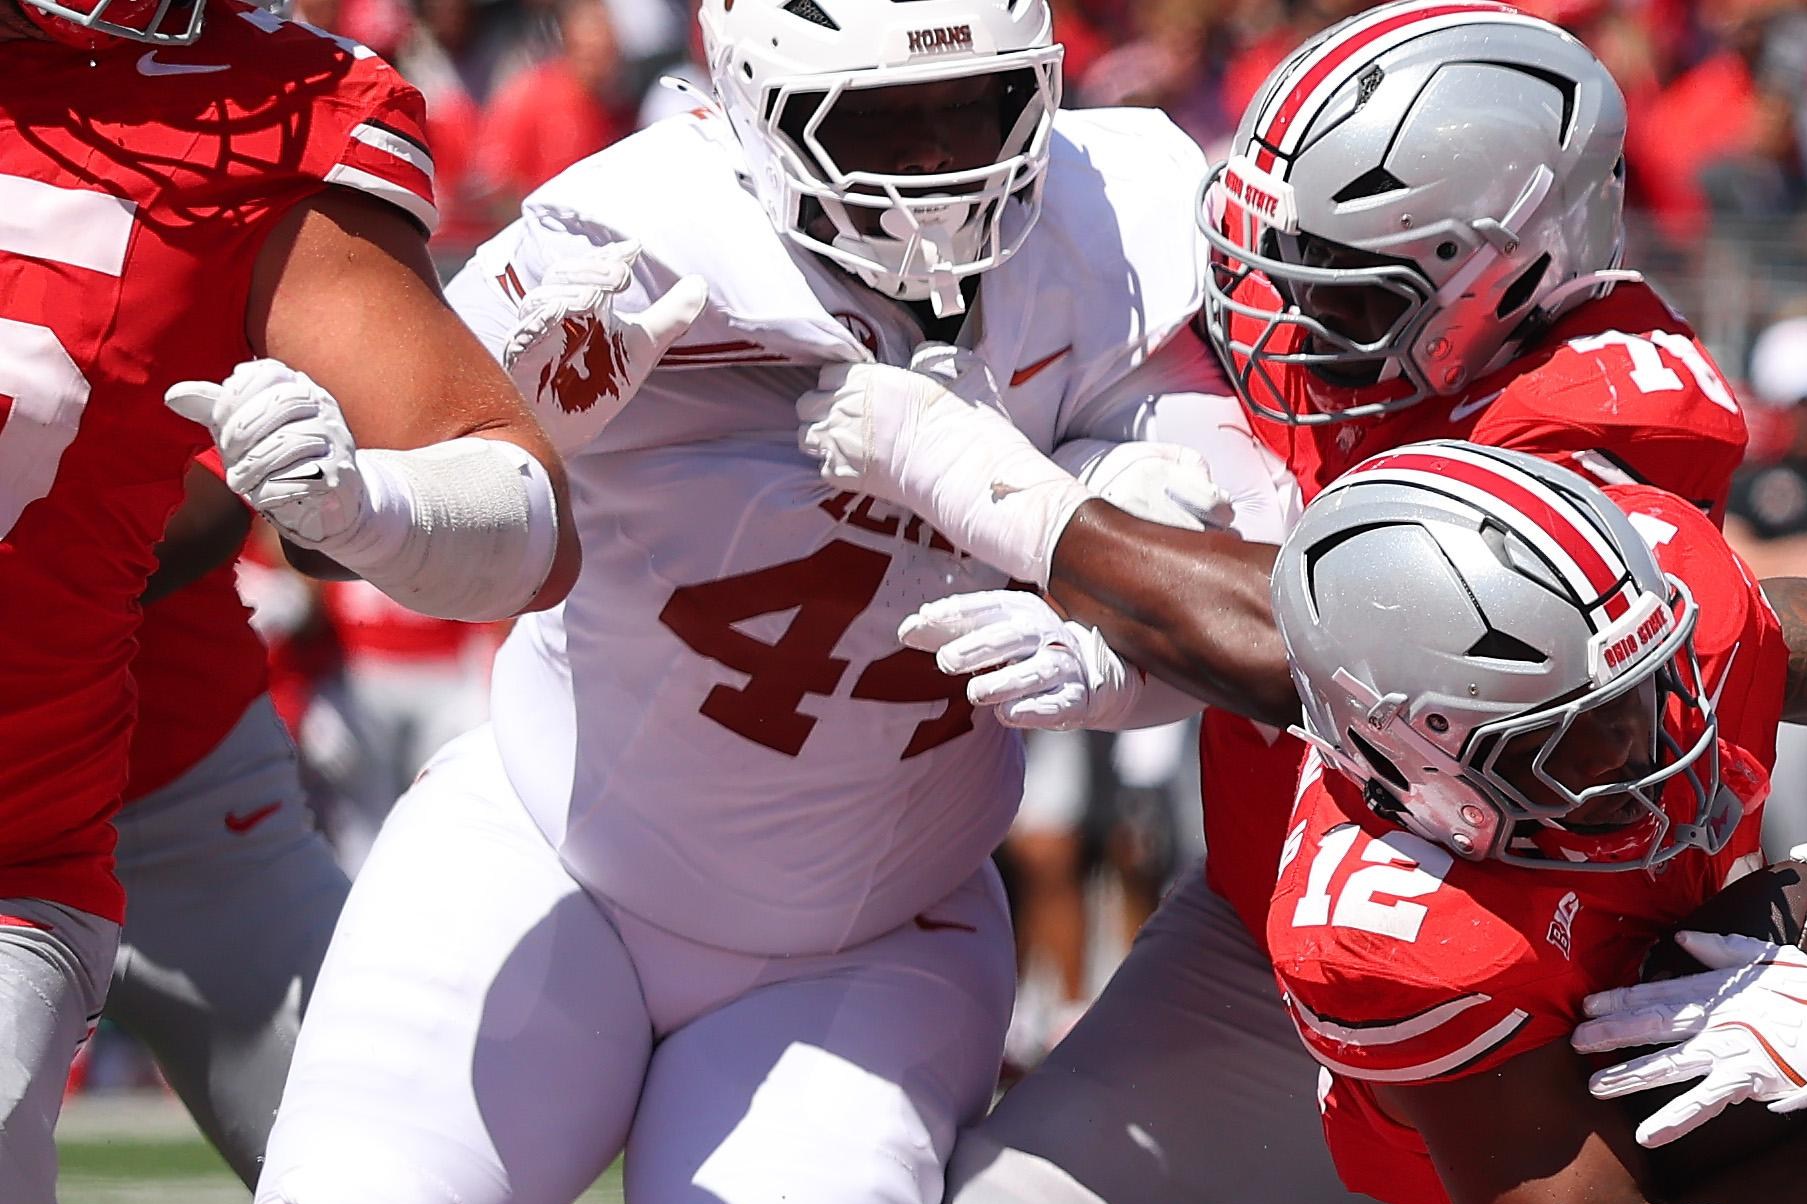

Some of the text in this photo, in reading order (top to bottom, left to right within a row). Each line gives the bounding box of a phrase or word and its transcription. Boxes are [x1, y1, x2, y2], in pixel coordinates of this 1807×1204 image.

[906, 24, 972, 53] HORNS
[1603, 605, 1668, 668] OHIO STATE
[1292, 824, 1454, 943] 12
